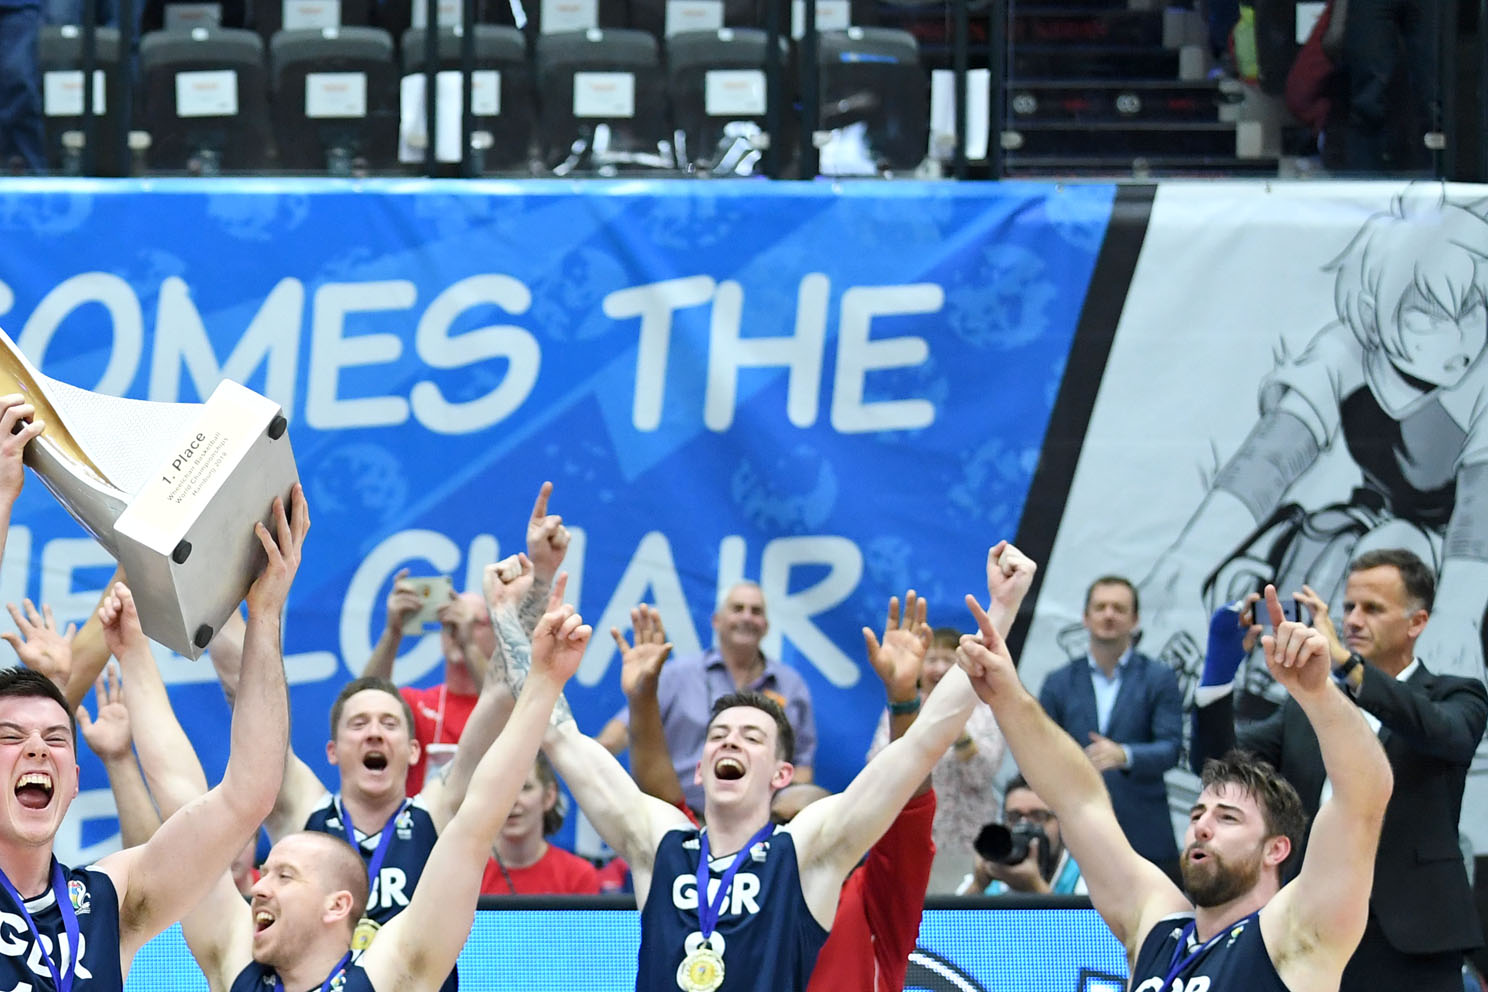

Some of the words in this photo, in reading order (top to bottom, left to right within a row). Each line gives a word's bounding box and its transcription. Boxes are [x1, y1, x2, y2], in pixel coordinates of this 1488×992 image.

[603, 272, 945, 433] THE
[172, 432, 206, 471] Place
[673, 873, 761, 916] GBR
